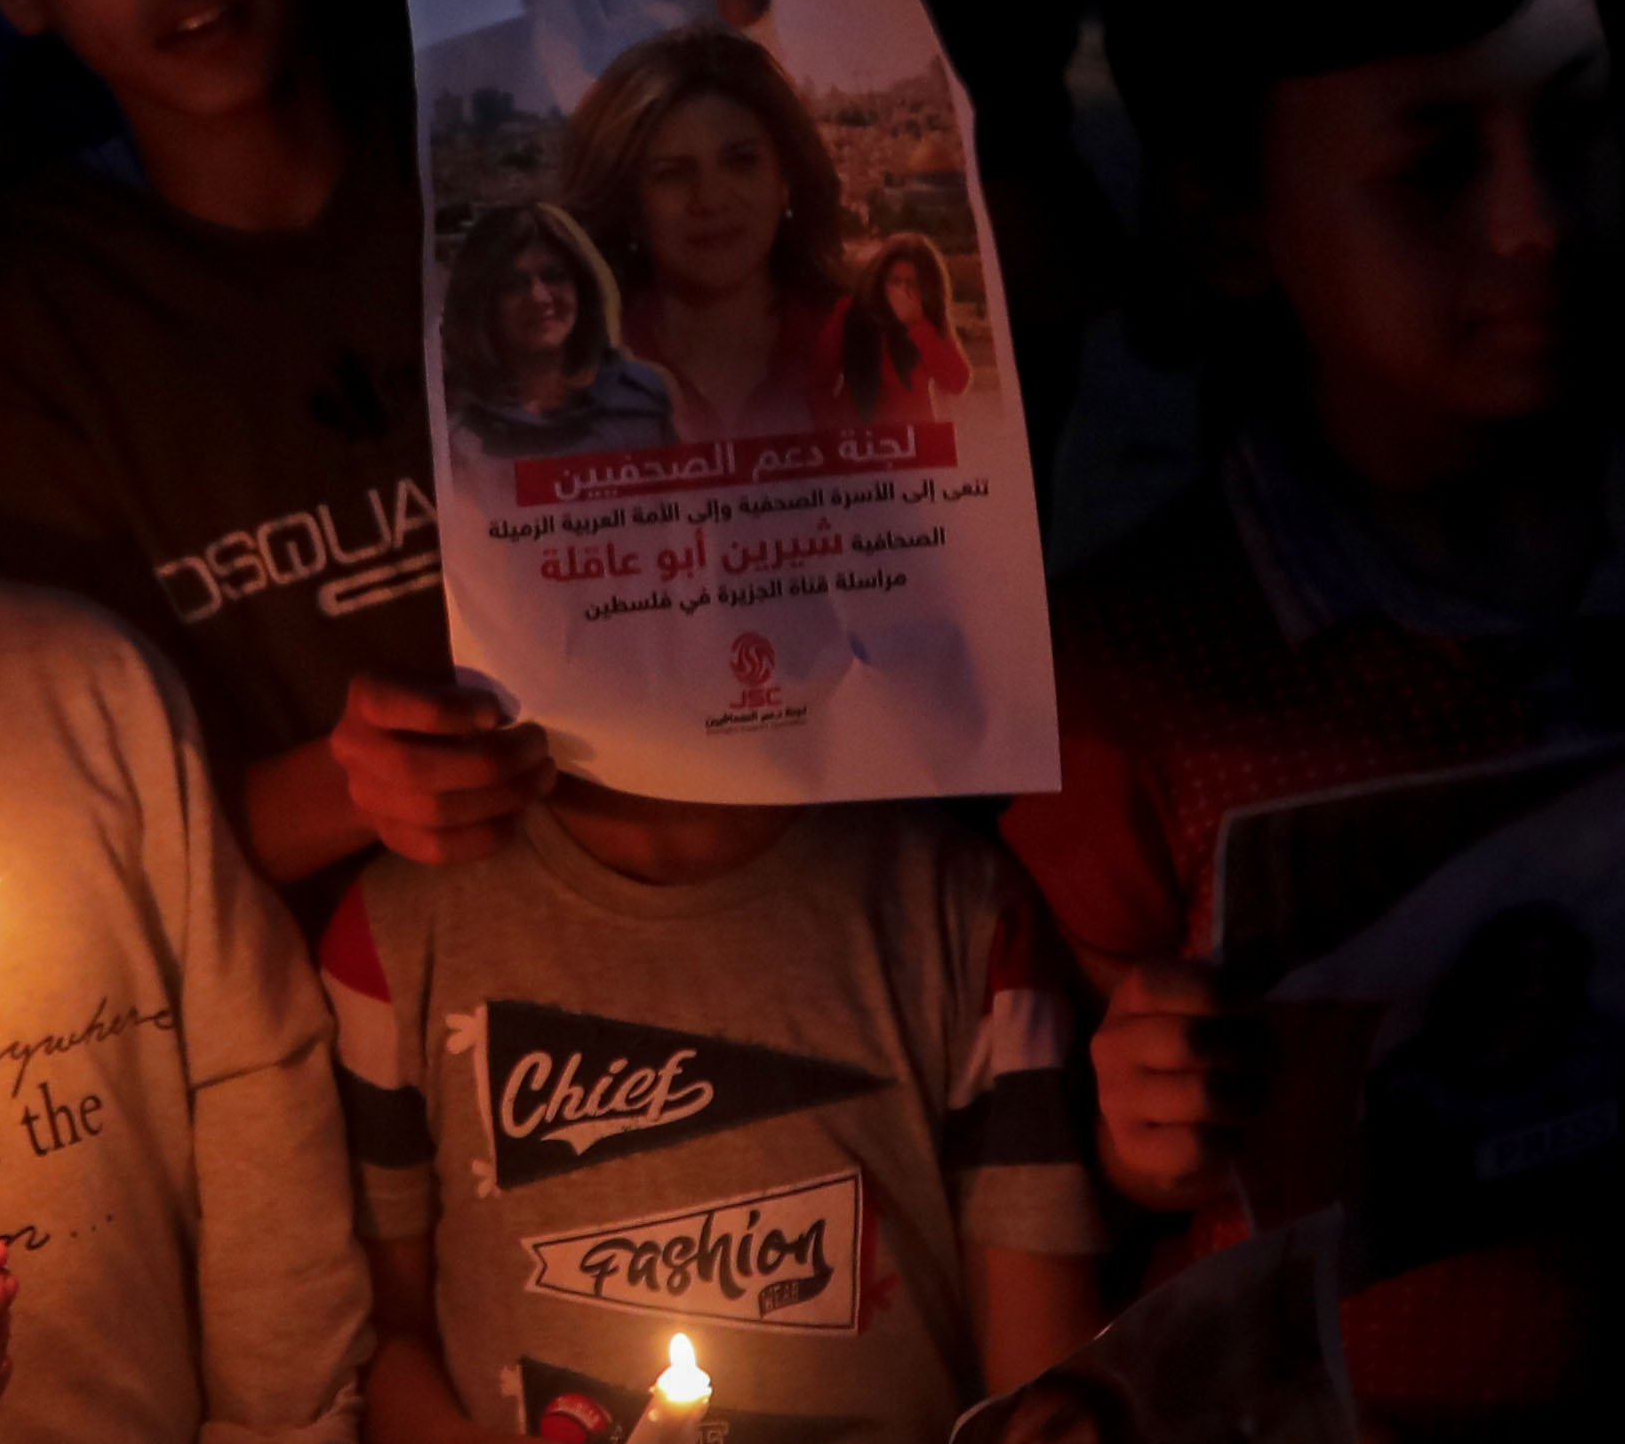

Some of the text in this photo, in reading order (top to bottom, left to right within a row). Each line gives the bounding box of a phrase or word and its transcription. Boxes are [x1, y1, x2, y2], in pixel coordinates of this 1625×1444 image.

[554, 425, 915, 503] لجنة دعم الصحفيين
[490, 482, 988, 538] تنعى إلى الأسرة الصحفية وإلى الأمة العربية الزميلة
[542, 519, 944, 580] الصحافية شيرين أبو عاقلة
[586, 571, 905, 619] مراسلة قناة الجزيرة في فلسطين
[20, 1081, 102, 1158] the
[501, 1049, 716, 1138] Chief
[580, 1209, 830, 1301] Fashion
